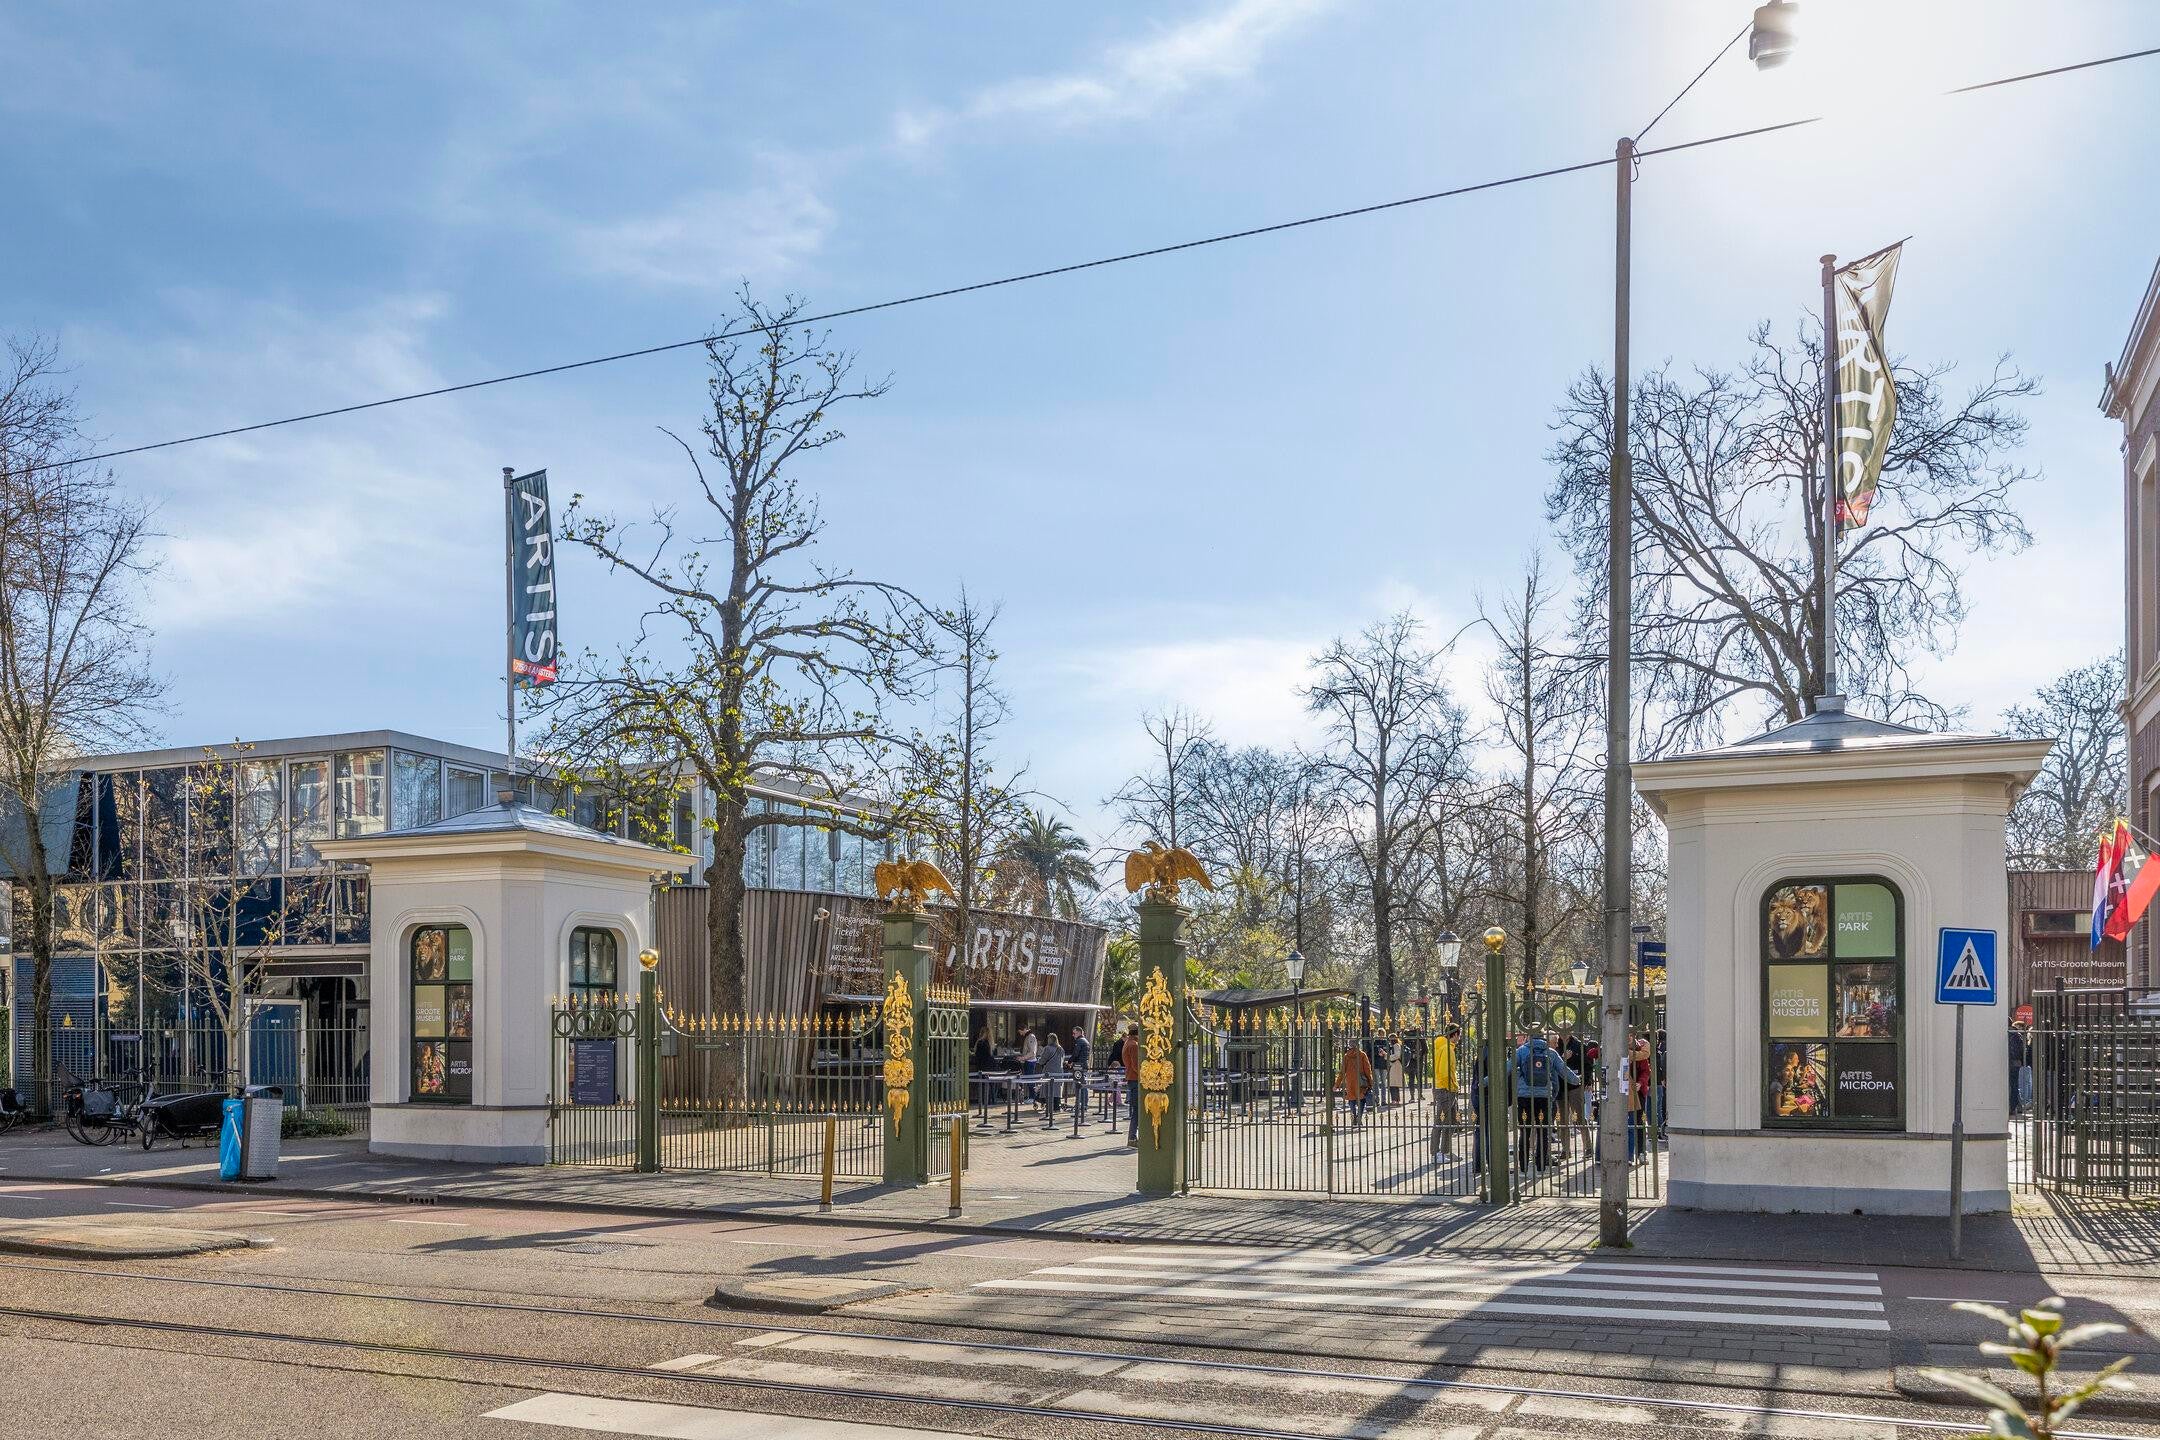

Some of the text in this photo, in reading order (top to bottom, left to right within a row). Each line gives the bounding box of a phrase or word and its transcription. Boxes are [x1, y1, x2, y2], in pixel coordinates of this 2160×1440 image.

[521, 491, 555, 662] ARTIS
[1838, 912, 1873, 921] ARTIS
[1838, 922, 1869, 931] PARK
[834, 926, 860, 938] Tickets
[2063, 977, 2124, 985] ARTIS-Micropia
[1772, 990, 1804, 998] ARTIS
[1772, 998, 1819, 1007] GROOTE
[1772, 1008, 1820, 1016] MUSEUM
[1839, 1071, 1873, 1080] ARTIS
[1839, 1081, 1895, 1090] MICROPIA
